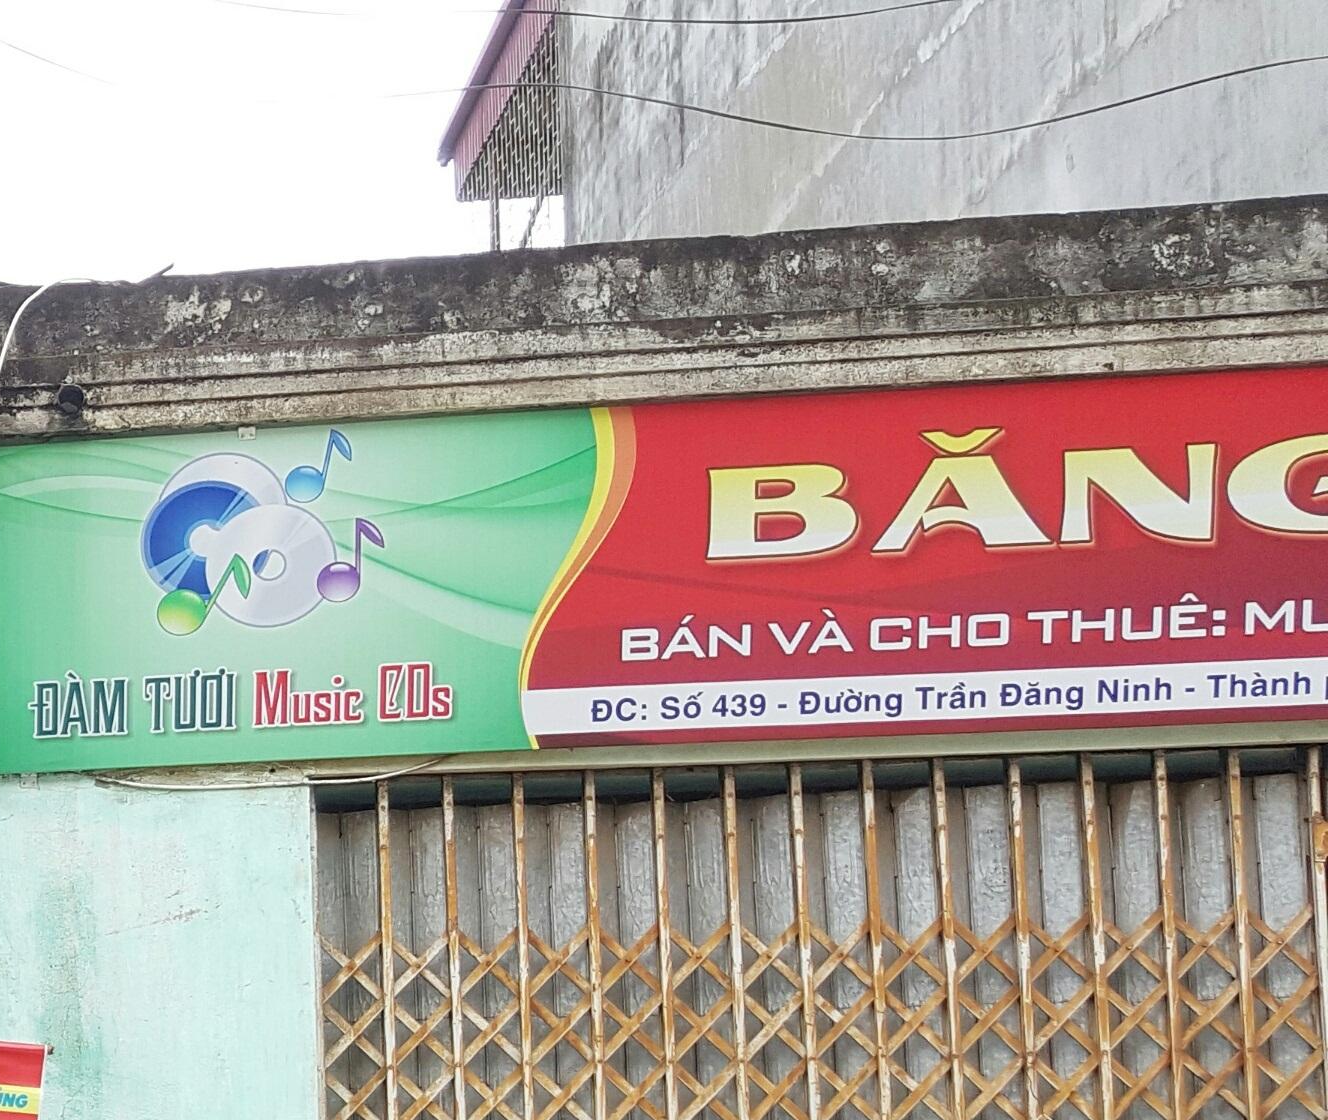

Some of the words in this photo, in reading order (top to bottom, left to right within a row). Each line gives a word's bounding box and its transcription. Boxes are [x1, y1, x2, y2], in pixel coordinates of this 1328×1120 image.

[706, 427, 1328, 561] BĂNG
[620, 614, 752, 662] BÁN
[768, 608, 854, 655] VÀ
[869, 611, 1010, 650] CHO
[1027, 592, 1227, 644] THUÊ:
[30, 670, 127, 738] ĐÀM
[143, 667, 237, 733] TƯƠI
[253, 670, 364, 727] Music
[591, 697, 648, 723] ĐC:
[660, 691, 704, 720] Số
[711, 693, 766, 718] 439
[799, 689, 902, 717] Đường
[915, 682, 986, 710] Trần
[1000, 682, 1084, 711] Đăng
[1097, 677, 1172, 703] Ninh
[1207, 671, 1311, 699] Thành
